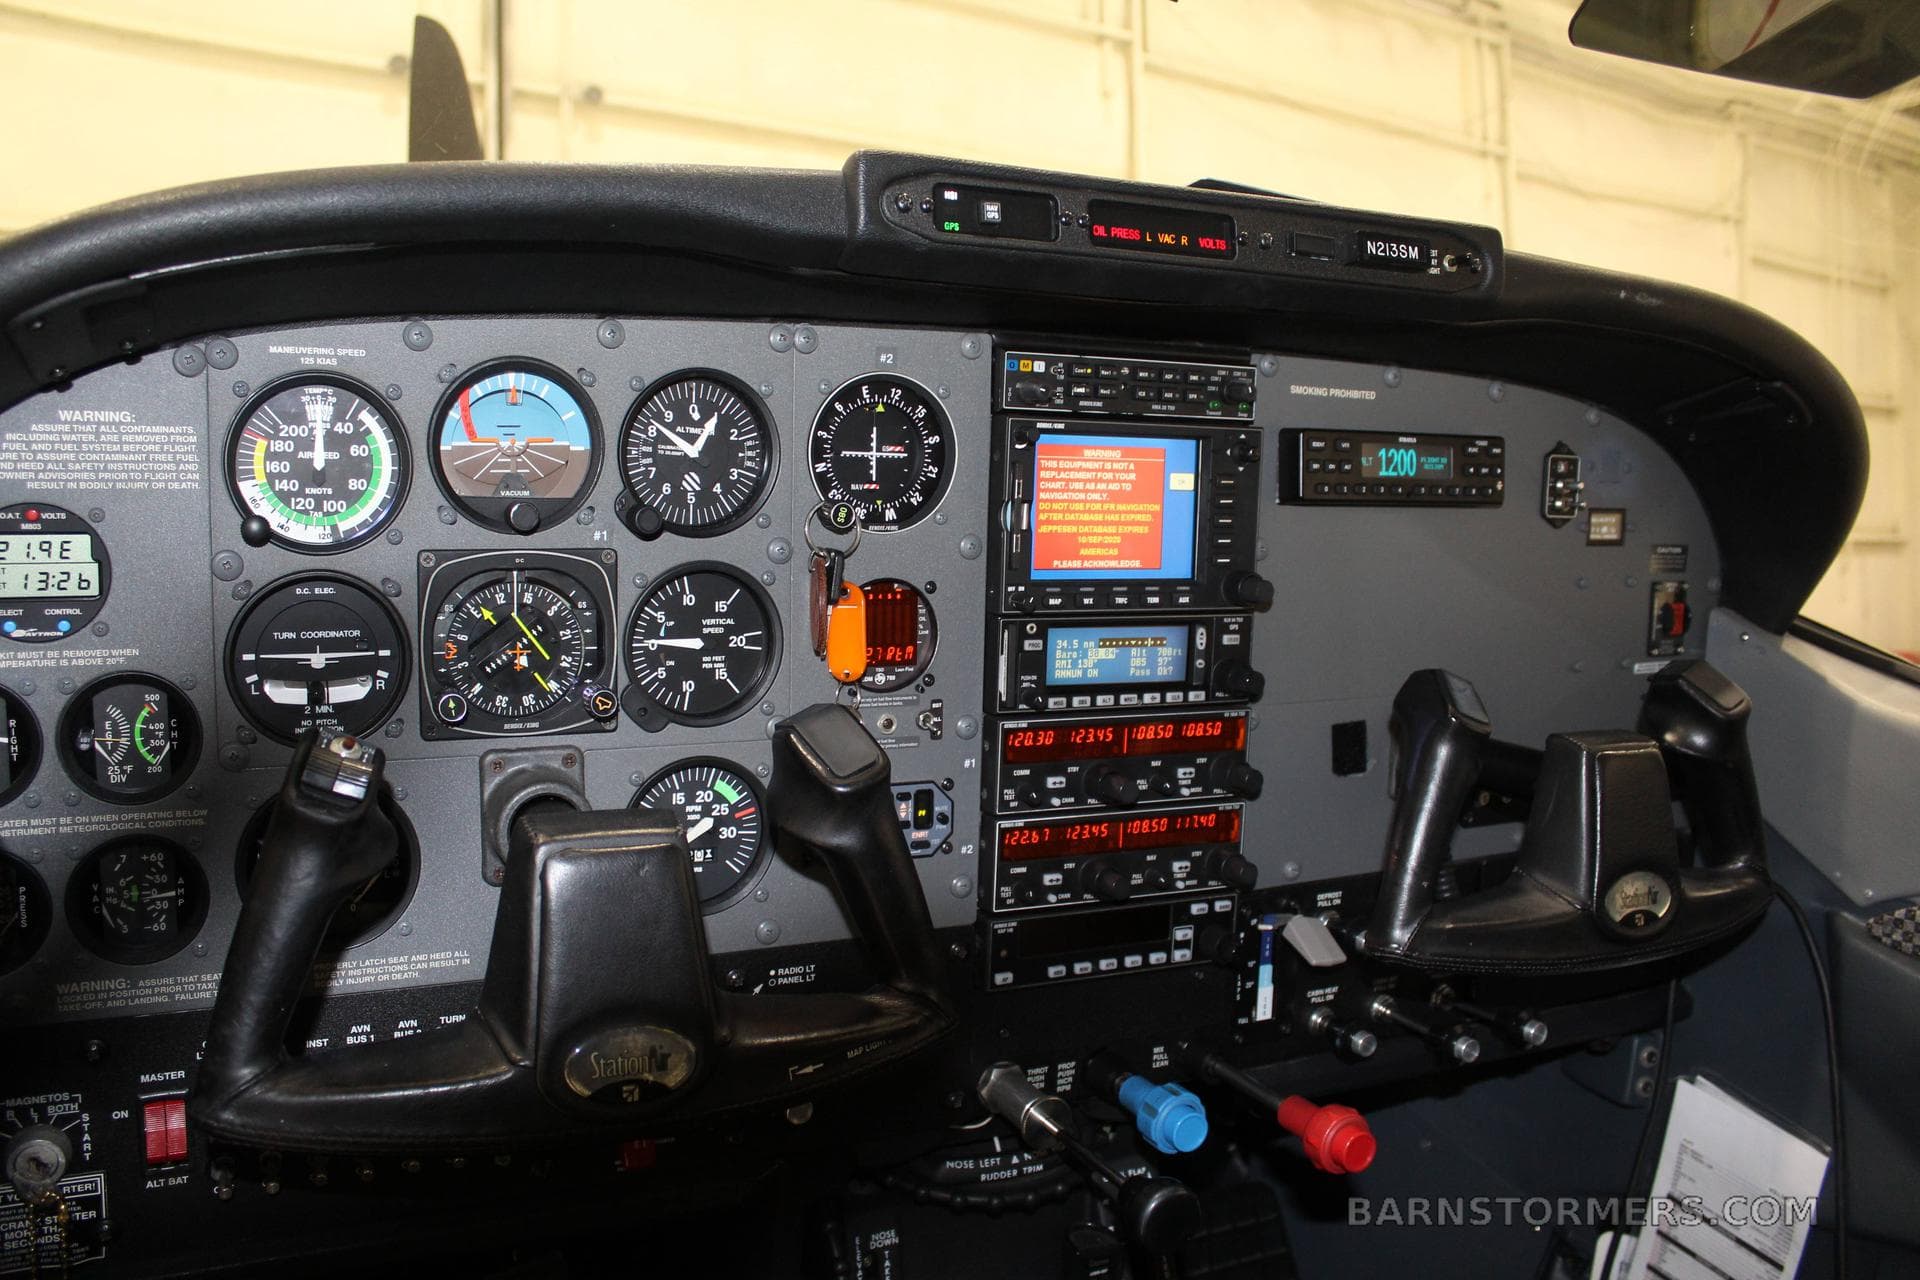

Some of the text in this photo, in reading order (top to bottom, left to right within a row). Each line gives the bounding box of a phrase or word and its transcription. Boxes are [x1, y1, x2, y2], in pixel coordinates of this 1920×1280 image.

[944, 221, 959, 232] GPS
[1093, 224, 1140, 240] OIL PRESS
[1146, 232, 1188, 246] L VAC R
[1199, 238, 1226, 250] VOLTS
[1367, 240, 1419, 260] N213SM
[269, 346, 366, 357] MANEUVERING SPEED
[880, 354, 893, 363] #2
[1290, 385, 1376, 400] SMOKING PROHIBITED
[58, 411, 136, 422] WARNING:
[279, 425, 308, 436] 200
[334, 422, 353, 434] 40
[62, 434, 97, 442] WATER,
[270, 441, 294, 452] 180
[350, 445, 369, 457] 60
[1084, 449, 1120, 457] WARNING
[266, 461, 290, 472] 160
[1040, 460, 1058, 468] THIS
[1059, 461, 1103, 469] EQUIPMENT
[1378, 448, 1416, 477] 1200
[1040, 471, 1097, 479] REPLACEMENT
[1098, 472, 1113, 480] FOR
[275, 480, 299, 491] 140
[348, 480, 367, 490] 80
[291, 498, 315, 509] 120
[323, 501, 347, 512] 100
[593, 530, 608, 541] #1
[300, 630, 360, 638] COORDINATOR
[729, 636, 746, 647] 20
[1056, 641, 1079, 649] 34.5
[305, 705, 334, 714] 2 MIN.
[1008, 722, 1222, 747] 120.30 123.45 108.50 108.50
[964, 759, 975, 768] #1
[111, 775, 127, 783] DIV
[695, 791, 713, 802] 20
[712, 804, 729, 815] 25
[30, 818, 56, 826] MUST
[59, 817, 72, 825] BE
[91, 814, 119, 822] WHEN
[122, 811, 173, 821] OPERATING
[59, 823, 146, 833] METEOROLOGICAL
[719, 828, 736, 839] 30
[1067, 824, 1108, 839] 123.45
[1128, 818, 1168, 833] 108.50
[961, 845, 973, 854] #2
[359, 949, 469, 967] LATCH SEAT AND HEED ALL
[346, 959, 459, 975] INSTRUCTIONS CAN RESULT
[778, 964, 816, 976] RADIO LT
[345, 971, 420, 985] INJURY OR DEATH.
[778, 973, 816, 985] PANEL LT
[351, 1024, 371, 1034] AVN
[398, 1019, 417, 1029] AVN
[346, 1034, 375, 1044] BUS 1
[141, 1070, 185, 1083] MASTER
[112, 1110, 128, 1119] ON
[946, 1157, 1001, 1169] NOSE LEFT
[980, 1164, 1043, 1182] RUDDER TRIM
[146, 1176, 189, 1188] ALT BAT
